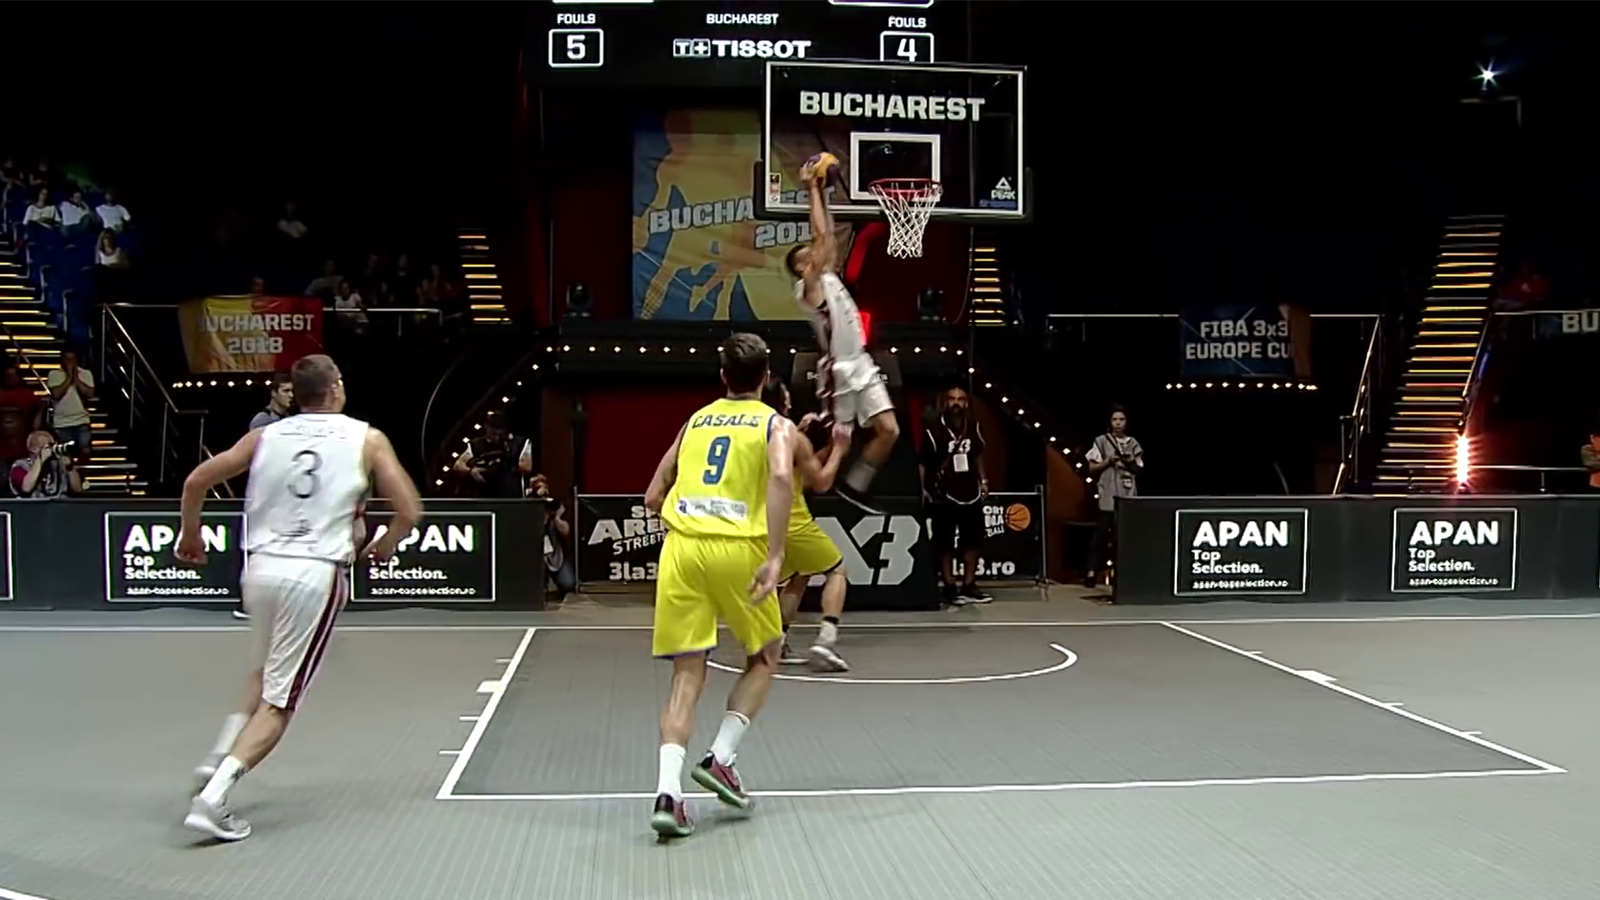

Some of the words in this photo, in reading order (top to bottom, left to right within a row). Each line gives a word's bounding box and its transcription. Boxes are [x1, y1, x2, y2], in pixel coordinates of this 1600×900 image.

[557, 13, 597, 25] FOULS
[706, 13, 779, 25] BUCHAREST
[888, 16, 927, 29] FOULS
[566, 34, 587, 60] 5
[711, 40, 812, 59] TISSOT
[896, 38, 918, 62] 4
[800, 91, 986, 122] BUCHAREST
[1200, 319, 1249, 338] FIBA
[1253, 320, 1289, 337] 3x3
[228, 337, 284, 354] 2018
[1186, 342, 1263, 359] EUROPE
[1267, 342, 1294, 359] CU
[702, 435, 731, 486] 9
[286, 449, 324, 500] 3
[124, 524, 227, 552] APN
[1192, 520, 1289, 548] APAN
[1409, 520, 1499, 546] APAN
[123, 553, 155, 570] Top
[1191, 549, 1221, 566] Top
[1408, 547, 1436, 564] Top
[124, 566, 202, 580] Selection.
[368, 566, 448, 580] Selection.
[1191, 562, 1264, 574] Selection.
[1408, 559, 1476, 572] Selection.
